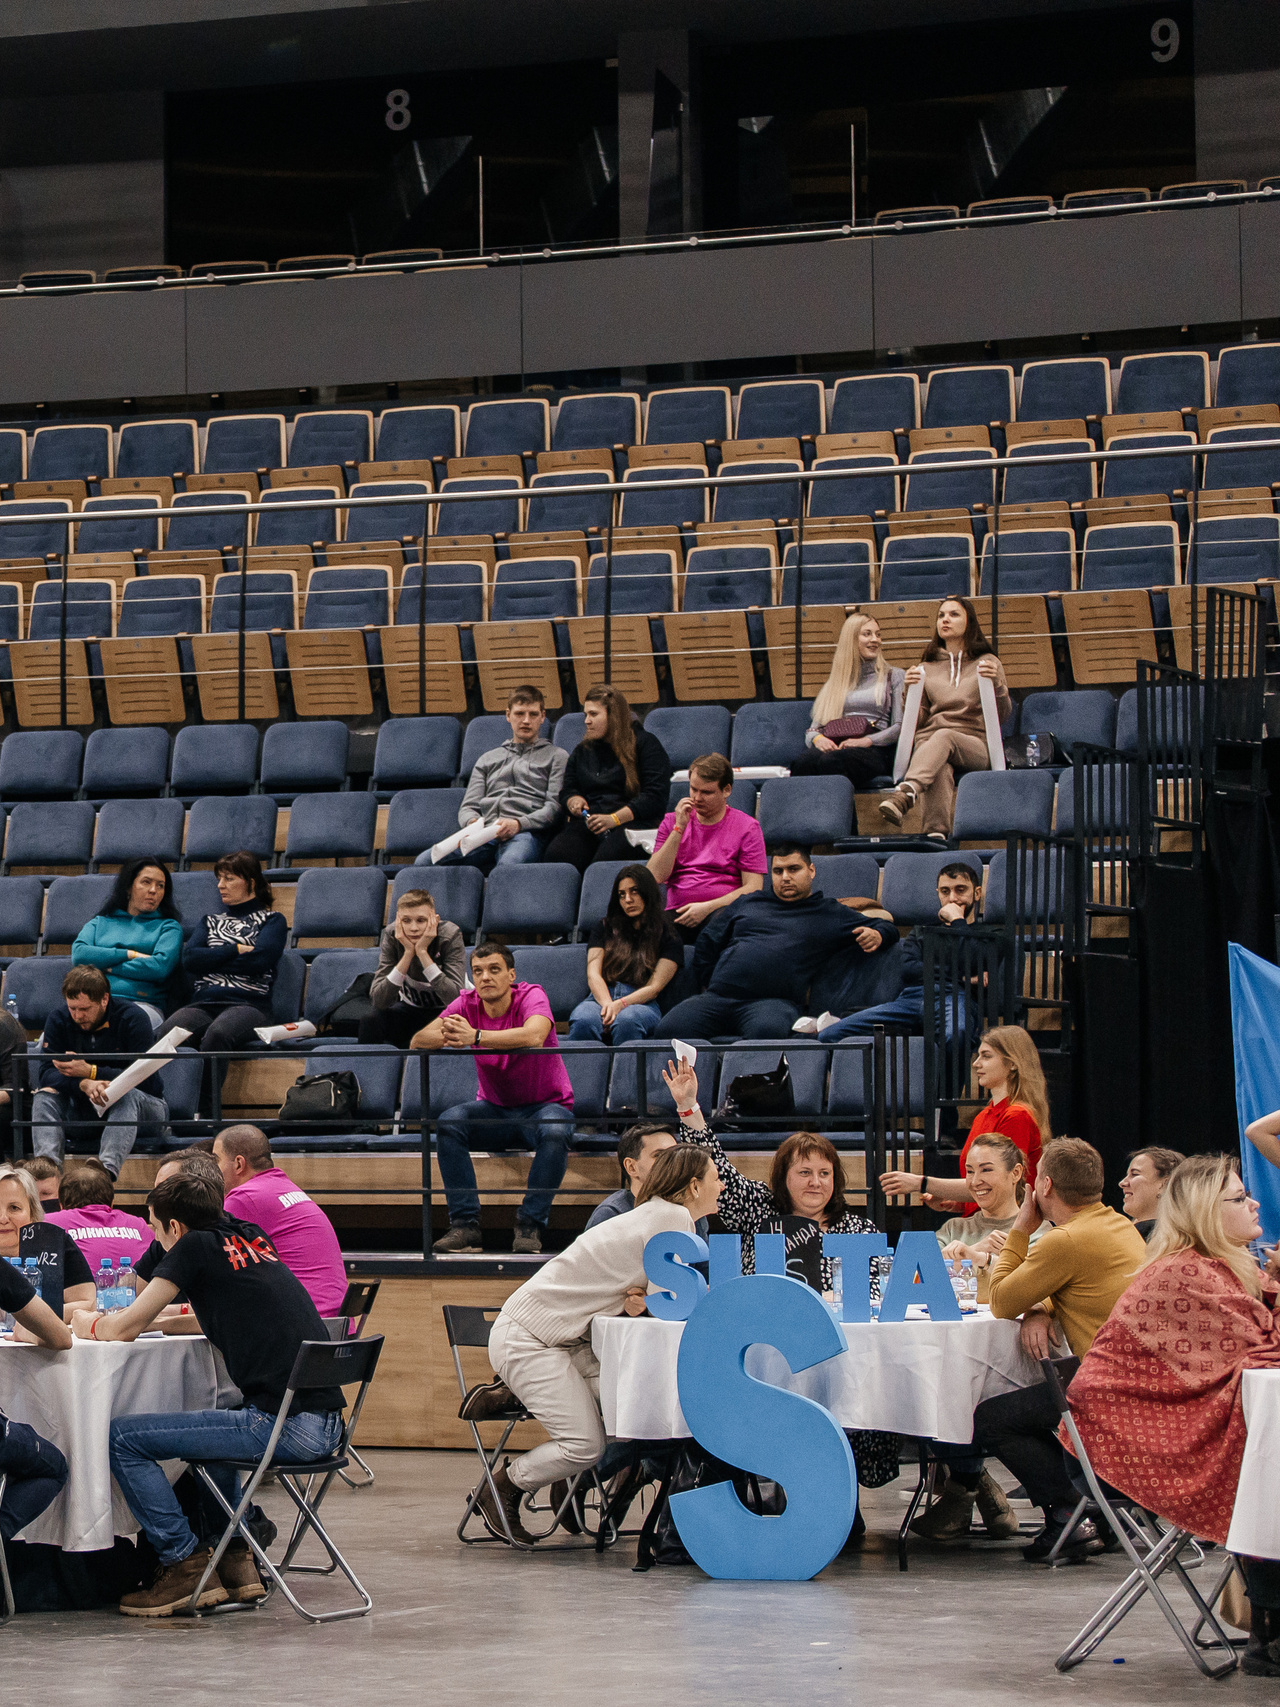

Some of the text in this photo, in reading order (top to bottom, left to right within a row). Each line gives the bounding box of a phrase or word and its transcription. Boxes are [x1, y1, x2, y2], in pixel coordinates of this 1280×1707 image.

[1150, 18, 1180, 62] 9
[385, 89, 411, 131] 8
[22, 1225, 35, 1241] 25
[769, 1220, 783, 1234] 14
[668, 1273, 858, 1581] S
